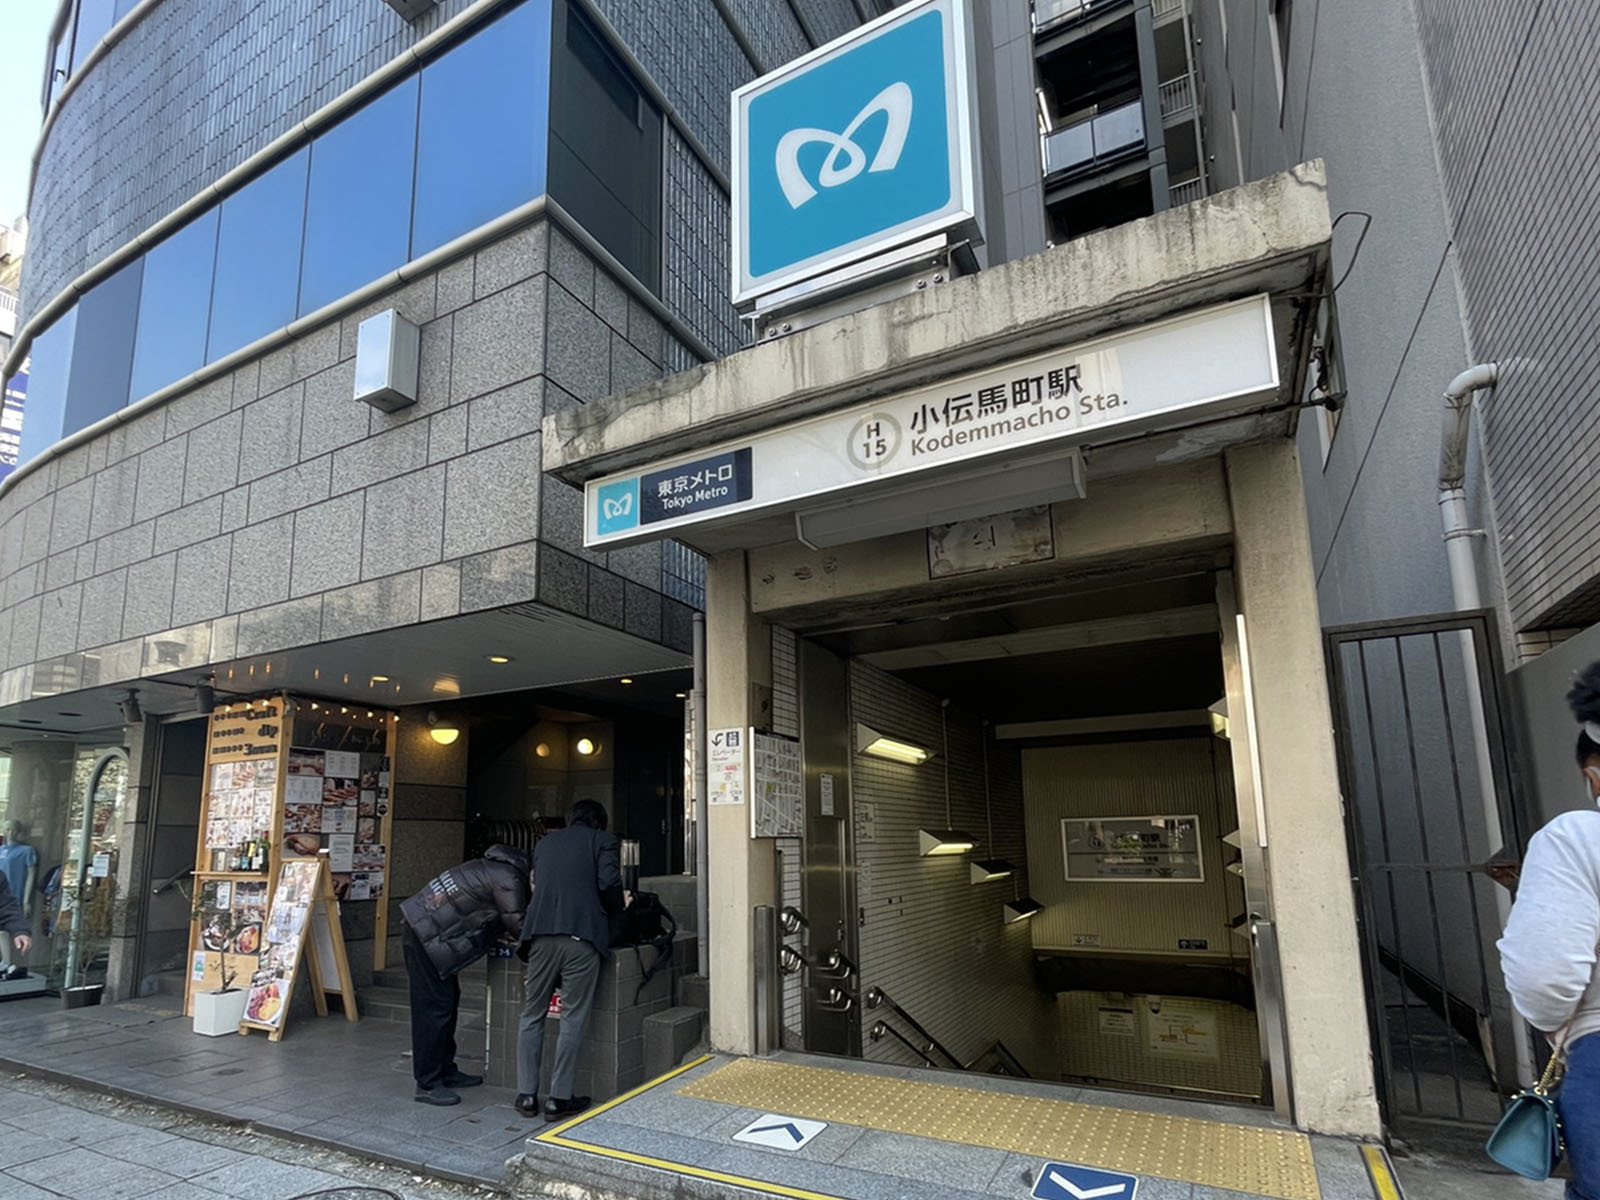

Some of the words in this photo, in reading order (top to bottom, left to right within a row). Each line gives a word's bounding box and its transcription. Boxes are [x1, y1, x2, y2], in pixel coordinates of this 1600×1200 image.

[910, 363, 1083, 435] 小伝馬町駅
[866, 422, 881, 439] H
[911, 404, 1071, 456] Kodemmacho
[1080, 391, 1129, 415] Sta.
[863, 439, 888, 459] 15
[657, 464, 733, 498] 東京メトロ
[662, 494, 694, 510] Tokyo
[695, 486, 728, 502] Metro
